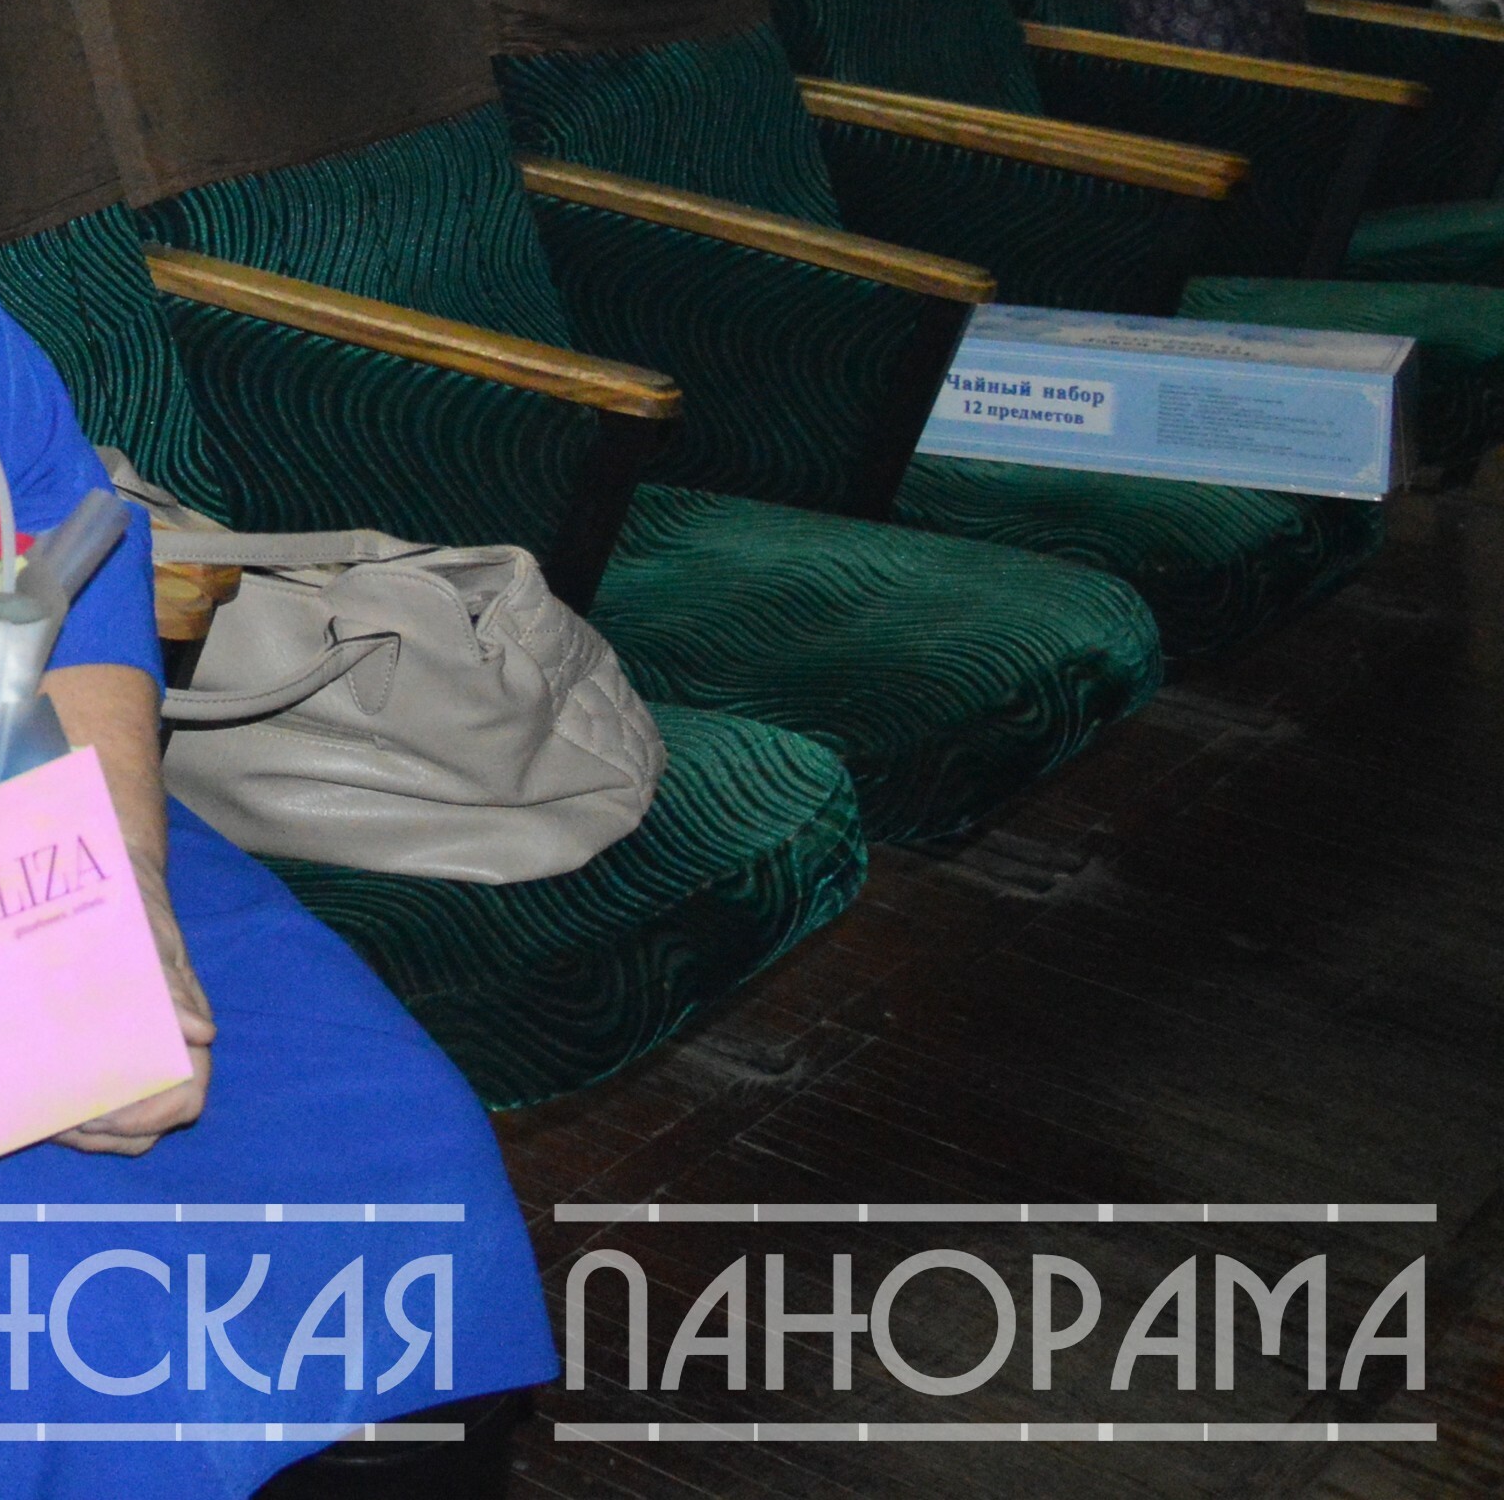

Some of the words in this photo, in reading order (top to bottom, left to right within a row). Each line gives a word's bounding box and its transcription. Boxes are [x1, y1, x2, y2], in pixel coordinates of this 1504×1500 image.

[947, 373, 1031, 397] Чайный
[1043, 385, 1105, 408] набор
[963, 400, 982, 415] 12
[987, 404, 1085, 425] предметов
